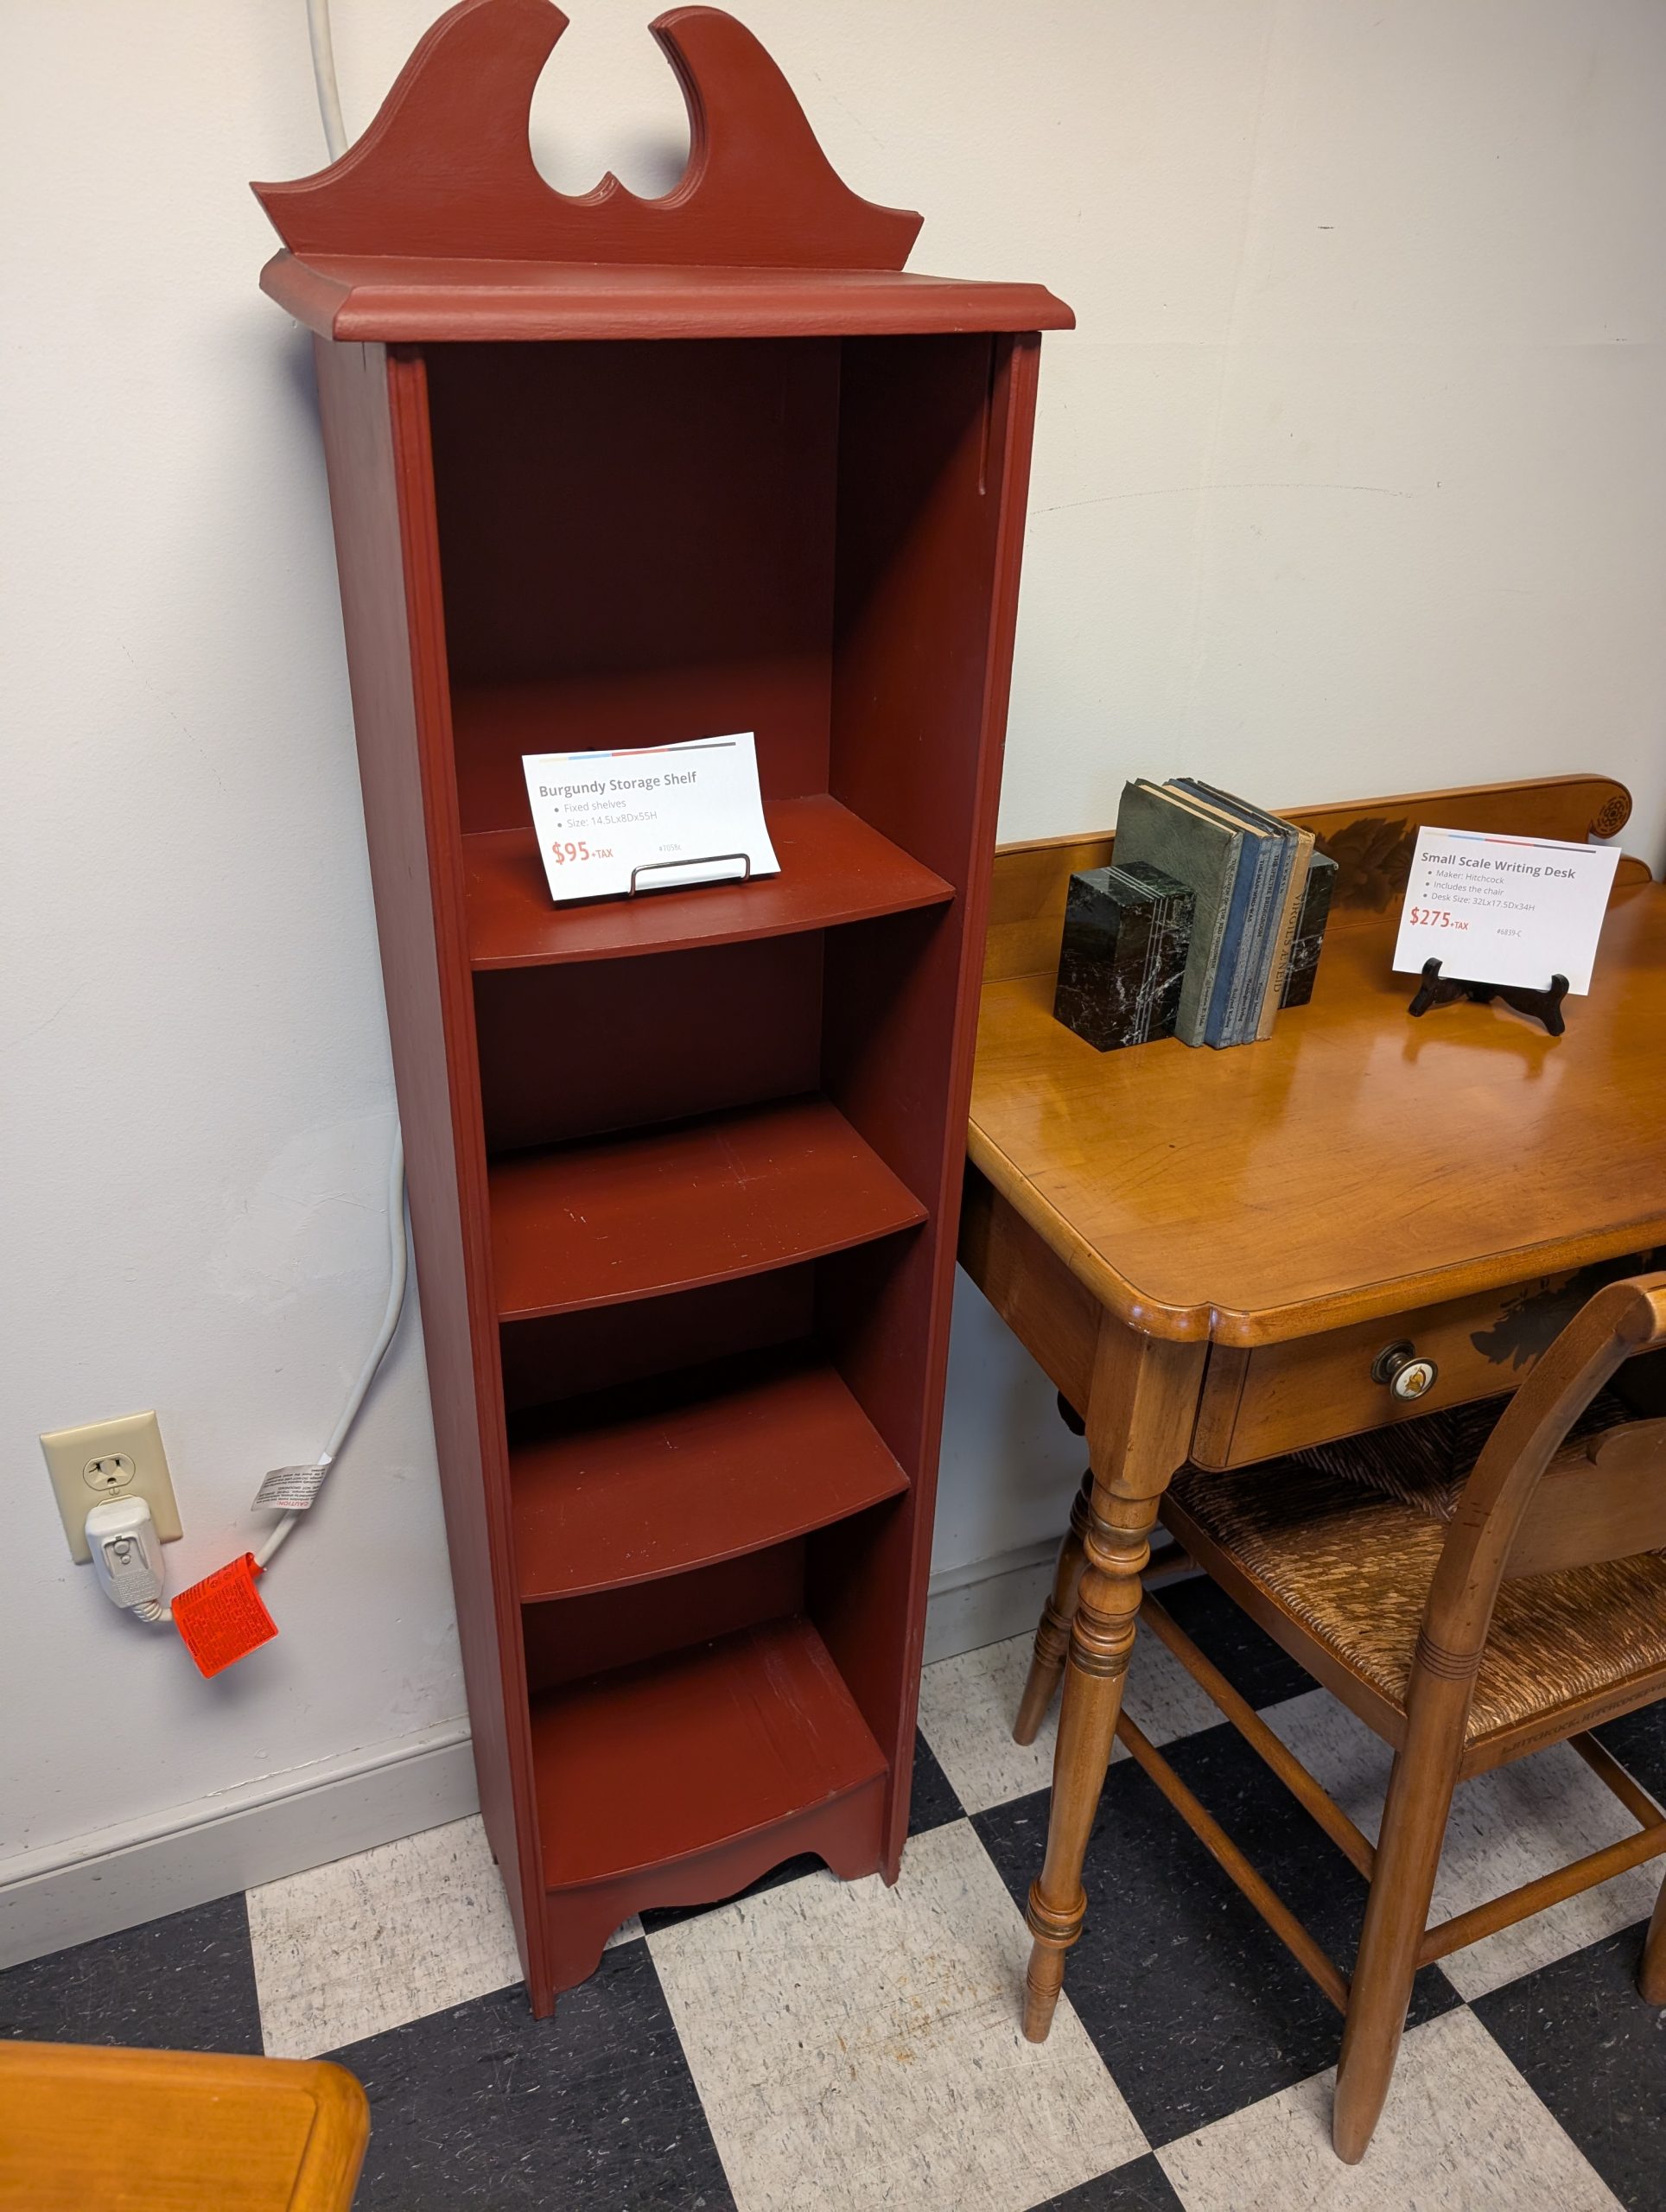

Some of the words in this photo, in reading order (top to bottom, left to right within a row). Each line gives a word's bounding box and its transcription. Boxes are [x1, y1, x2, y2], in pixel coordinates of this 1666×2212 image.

[539, 780, 606, 798] Burgundy
[609, 776, 661, 791] Storage
[664, 772, 696, 785] Shelf
[563, 801, 589, 813] Fixed
[591, 799, 626, 810] shelves
[566, 817, 589, 828] Size:
[591, 811, 658, 825] 14.5Lx8Dx55H
[1421, 852, 1456, 865] Small
[1459, 856, 1491, 869] Scale
[1495, 861, 1542, 877] Writing
[1544, 866, 1576, 879] Desk
[1436, 869, 1464, 880] Maker:
[1466, 873, 1505, 884] Hitchcock
[1434, 880, 1467, 892] Includes
[1468, 885, 1481, 893] the
[1484, 887, 1505, 896] chair
[1431, 893, 1451, 902] Desk
[1453, 894, 1471, 904] Size:
[1472, 898, 1536, 912] 32Lx17.5Dx34H
